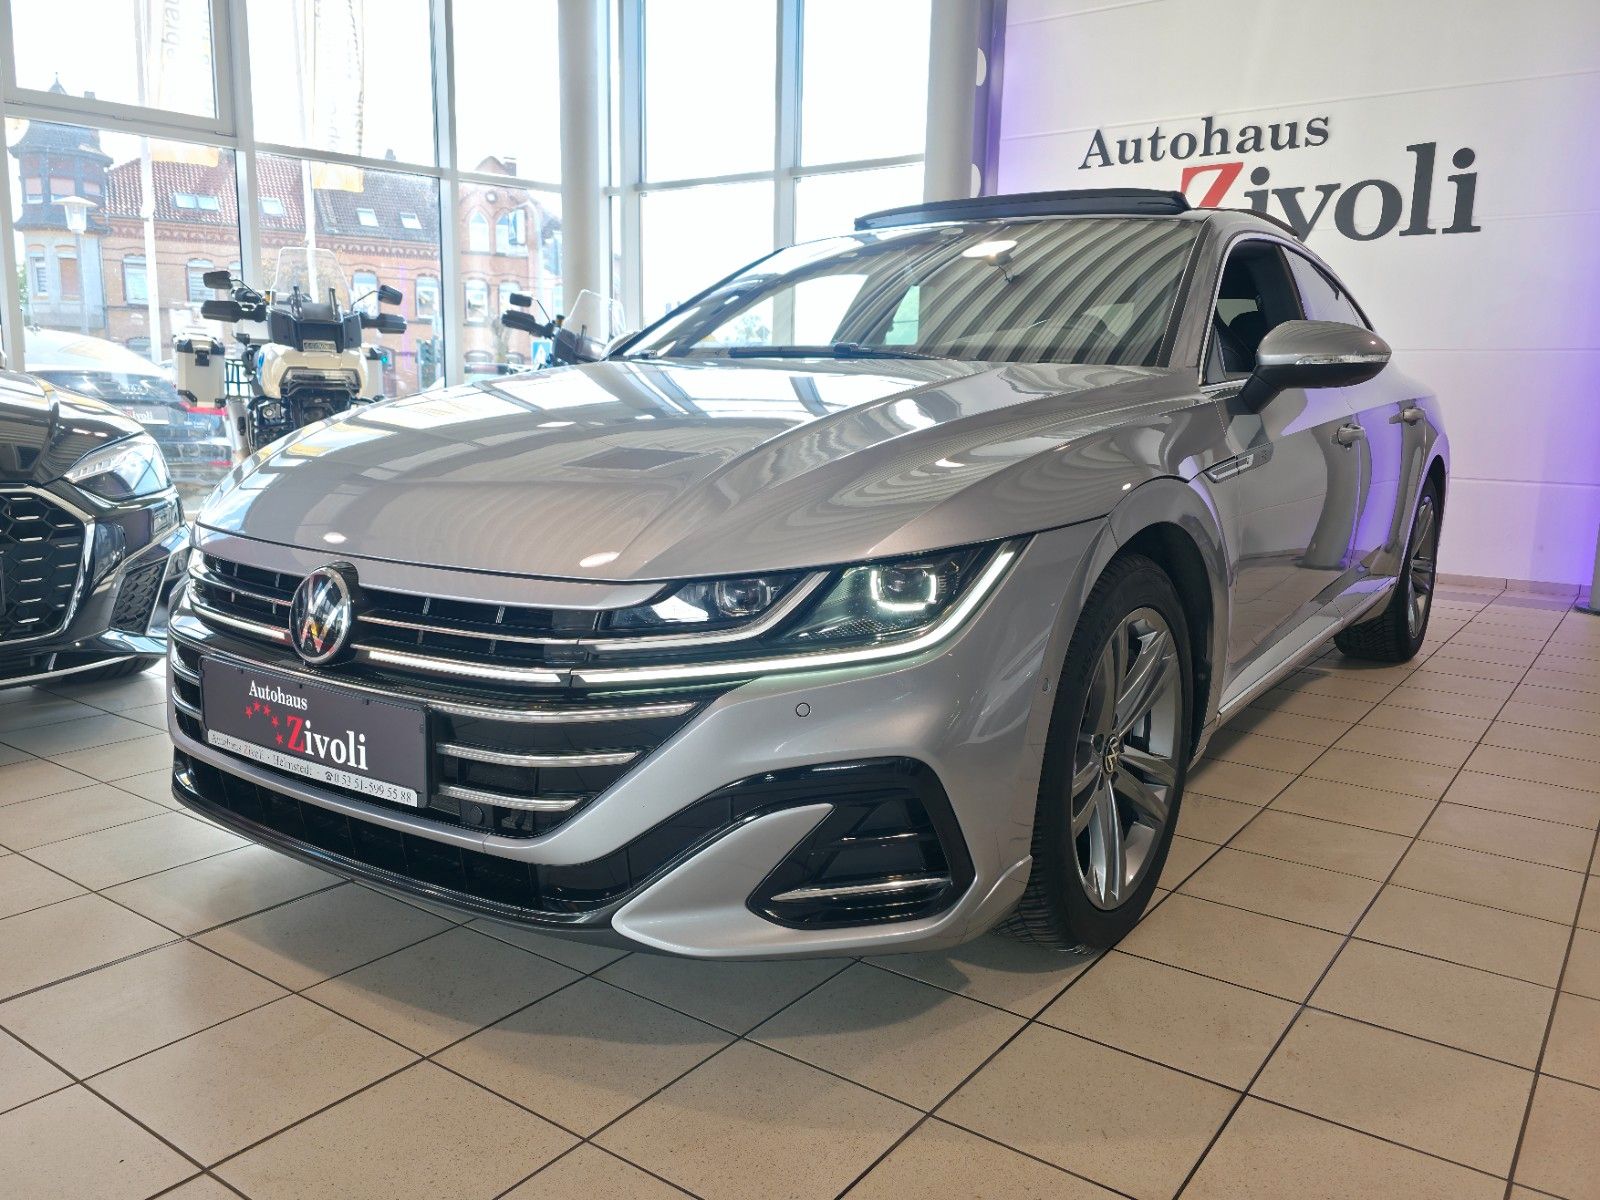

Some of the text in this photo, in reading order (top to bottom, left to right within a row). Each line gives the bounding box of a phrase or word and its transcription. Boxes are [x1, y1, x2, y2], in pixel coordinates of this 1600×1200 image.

[1078, 116, 1330, 170] Autohaus
[1180, 142, 1481, 242] Zivoli
[248, 680, 308, 711] Autohaus
[286, 715, 368, 770] Zivoli
